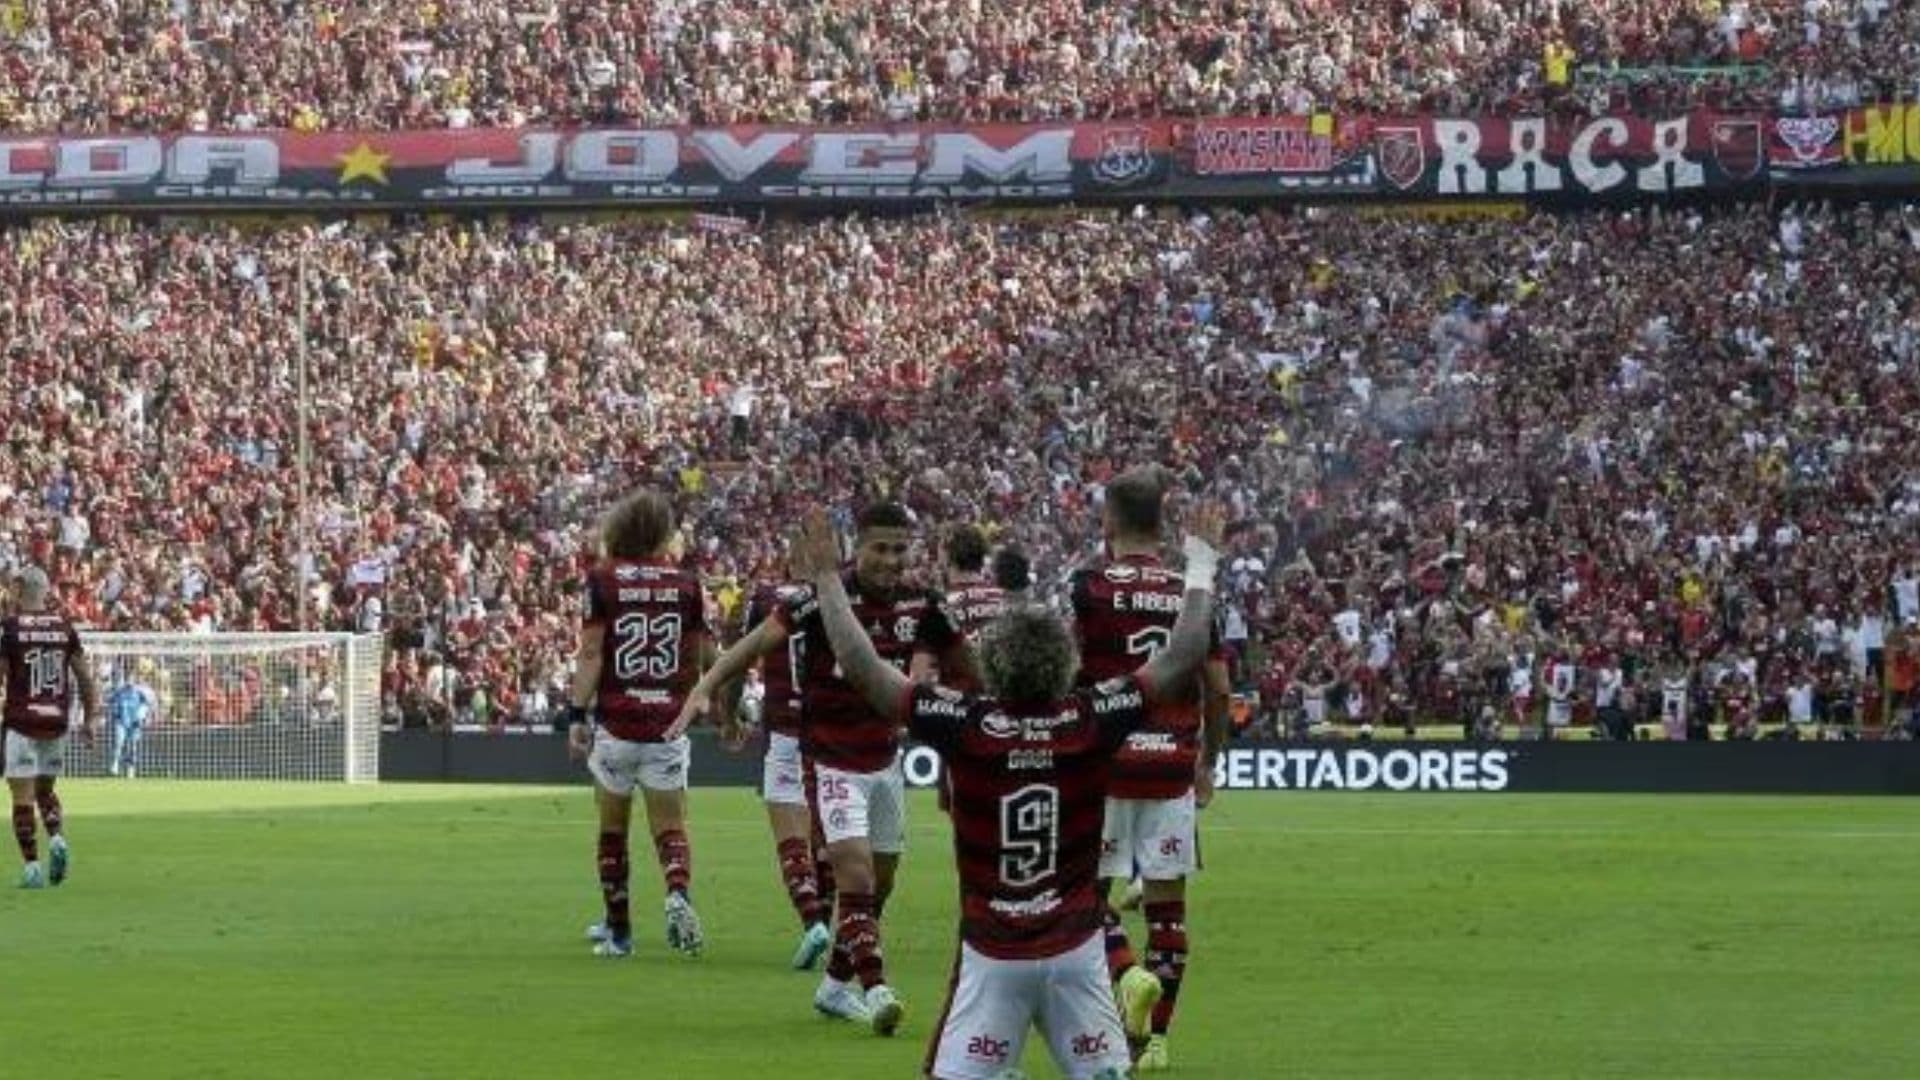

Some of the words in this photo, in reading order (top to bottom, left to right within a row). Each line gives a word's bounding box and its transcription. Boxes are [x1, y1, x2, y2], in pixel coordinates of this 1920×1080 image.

[444, 130, 1074, 184] JOVEM
[23, 647, 65, 698] 14
[616, 612, 682, 680] 23
[1000, 783, 1059, 887] 9
[967, 1033, 1010, 1058] abc
